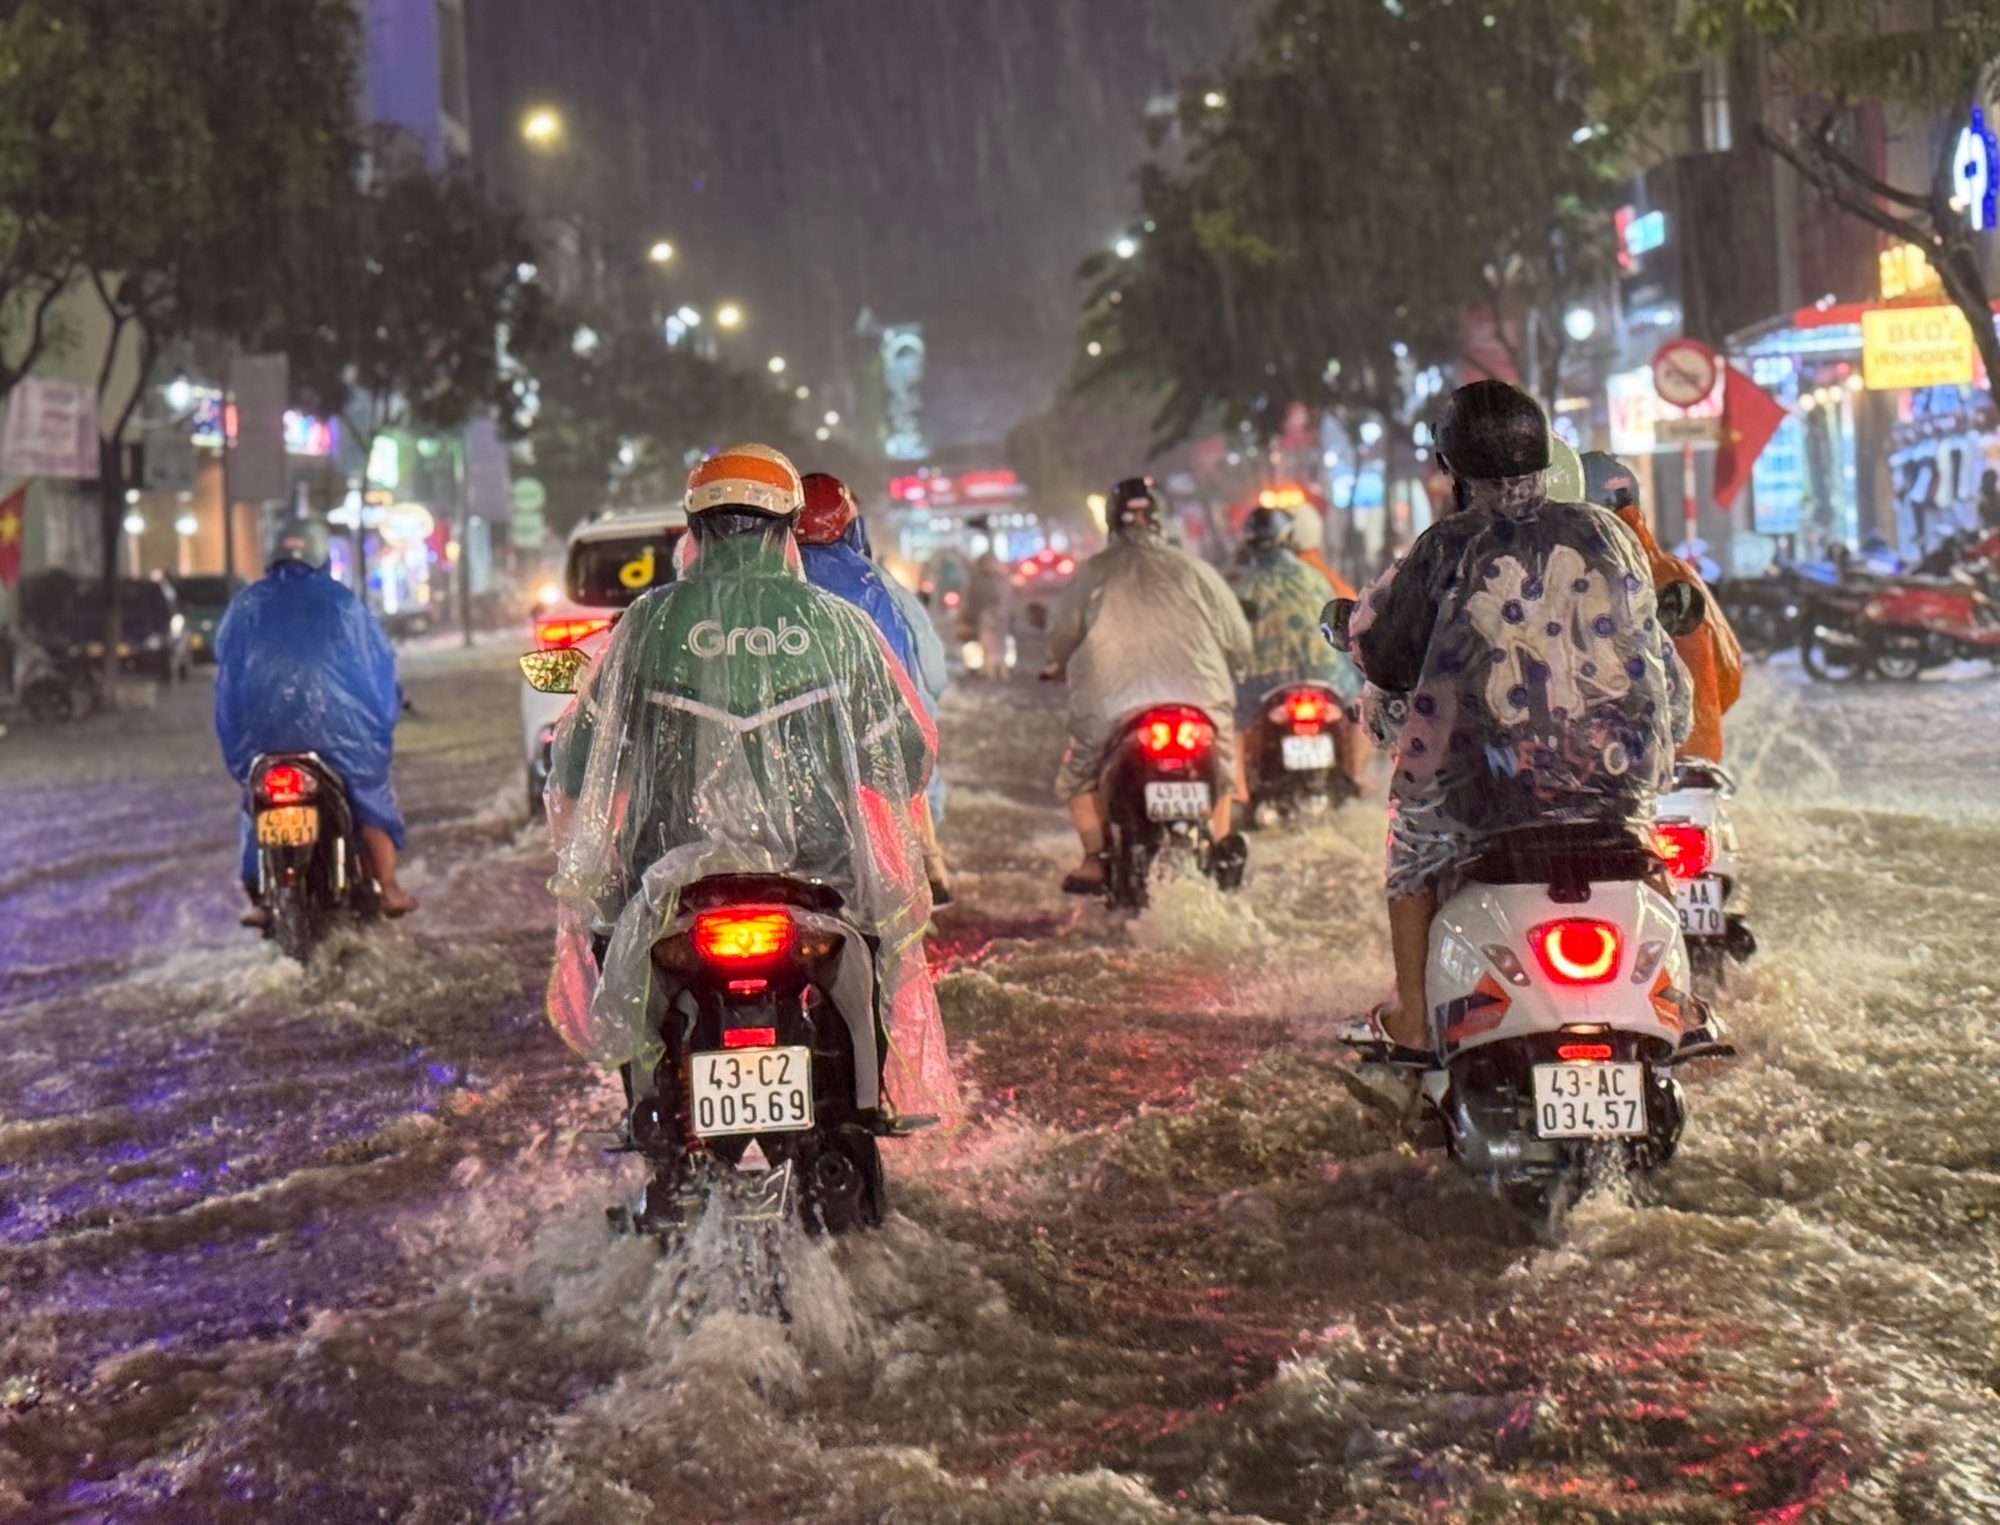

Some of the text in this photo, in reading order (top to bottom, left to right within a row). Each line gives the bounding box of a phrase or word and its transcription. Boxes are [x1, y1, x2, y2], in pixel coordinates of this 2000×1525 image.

[687, 616, 811, 658] Grab
[709, 1053, 792, 1091] 43-C2
[1551, 1068, 1626, 1097] 43-AC
[699, 1089, 805, 1128] 005.69
[1542, 1100, 1637, 1131] 034.57
